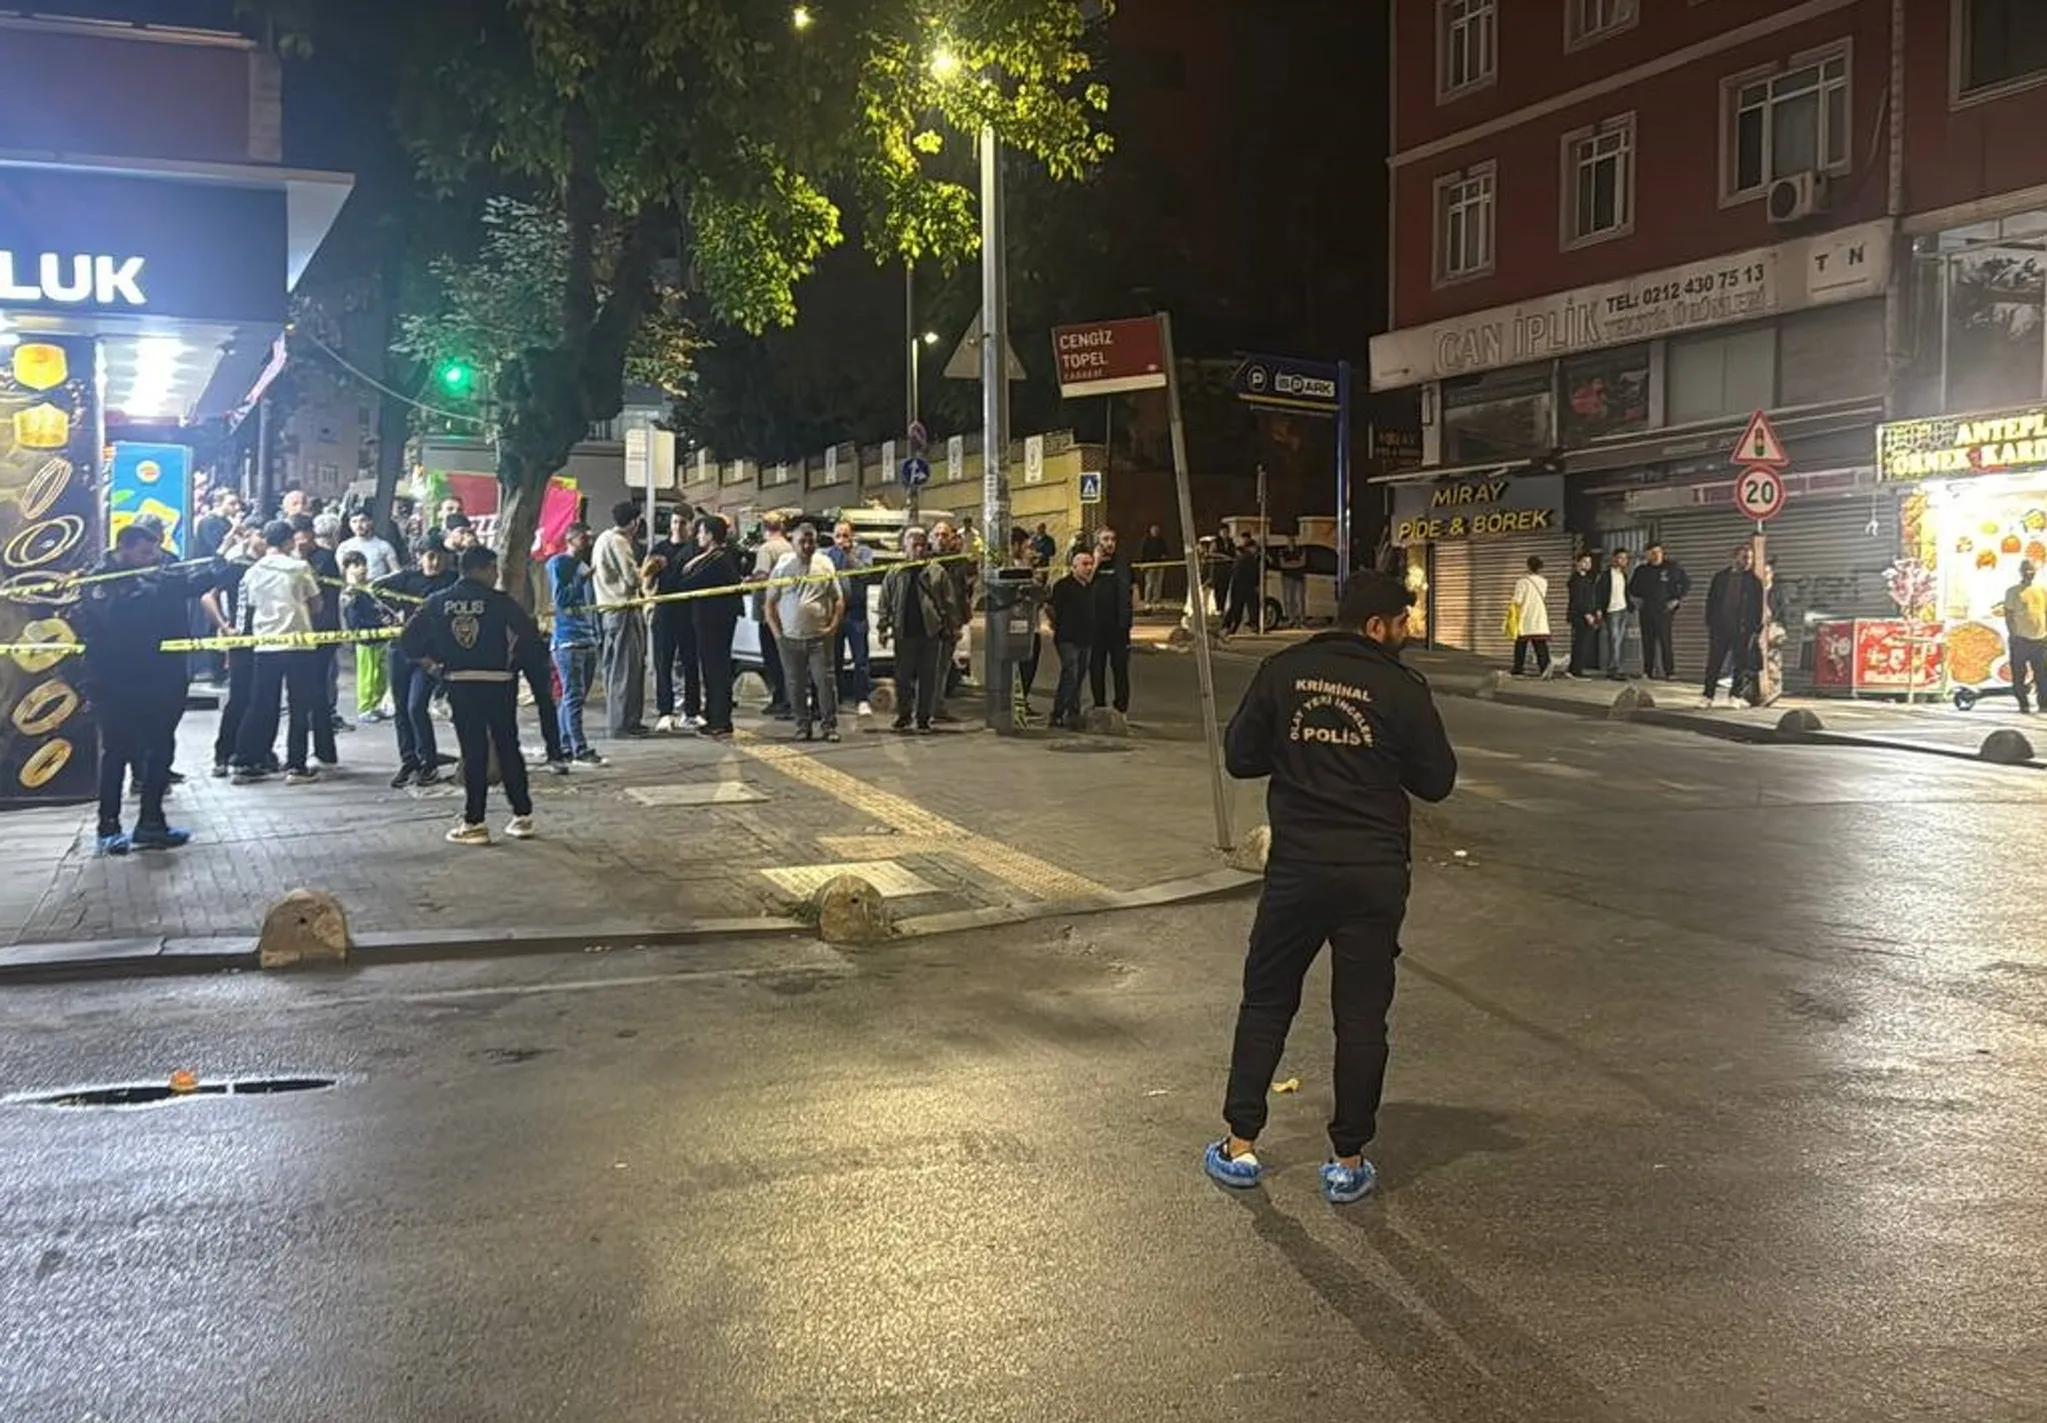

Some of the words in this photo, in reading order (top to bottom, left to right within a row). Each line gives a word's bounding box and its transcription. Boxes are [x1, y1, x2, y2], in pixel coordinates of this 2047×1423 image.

[0, 250, 148, 305] LUK
[1606, 294, 1639, 314] TEL:
[1642, 282, 1680, 307] 0212
[1684, 276, 1714, 294] 430
[1720, 268, 1739, 288] 75
[1746, 263, 1764, 283] 13
[1513, 294, 1601, 358] İPLİK
[1060, 328, 1113, 350] CENGİZ
[1062, 351, 1108, 369] TOPEL
[1431, 481, 1504, 507] MİRAY
[1746, 480, 1774, 504] 20
[1399, 515, 1441, 540] PİDE
[1449, 516, 1464, 536] &
[1296, 678, 1371, 702] KRİMİNAL
[1303, 726, 1361, 746] POLİS
